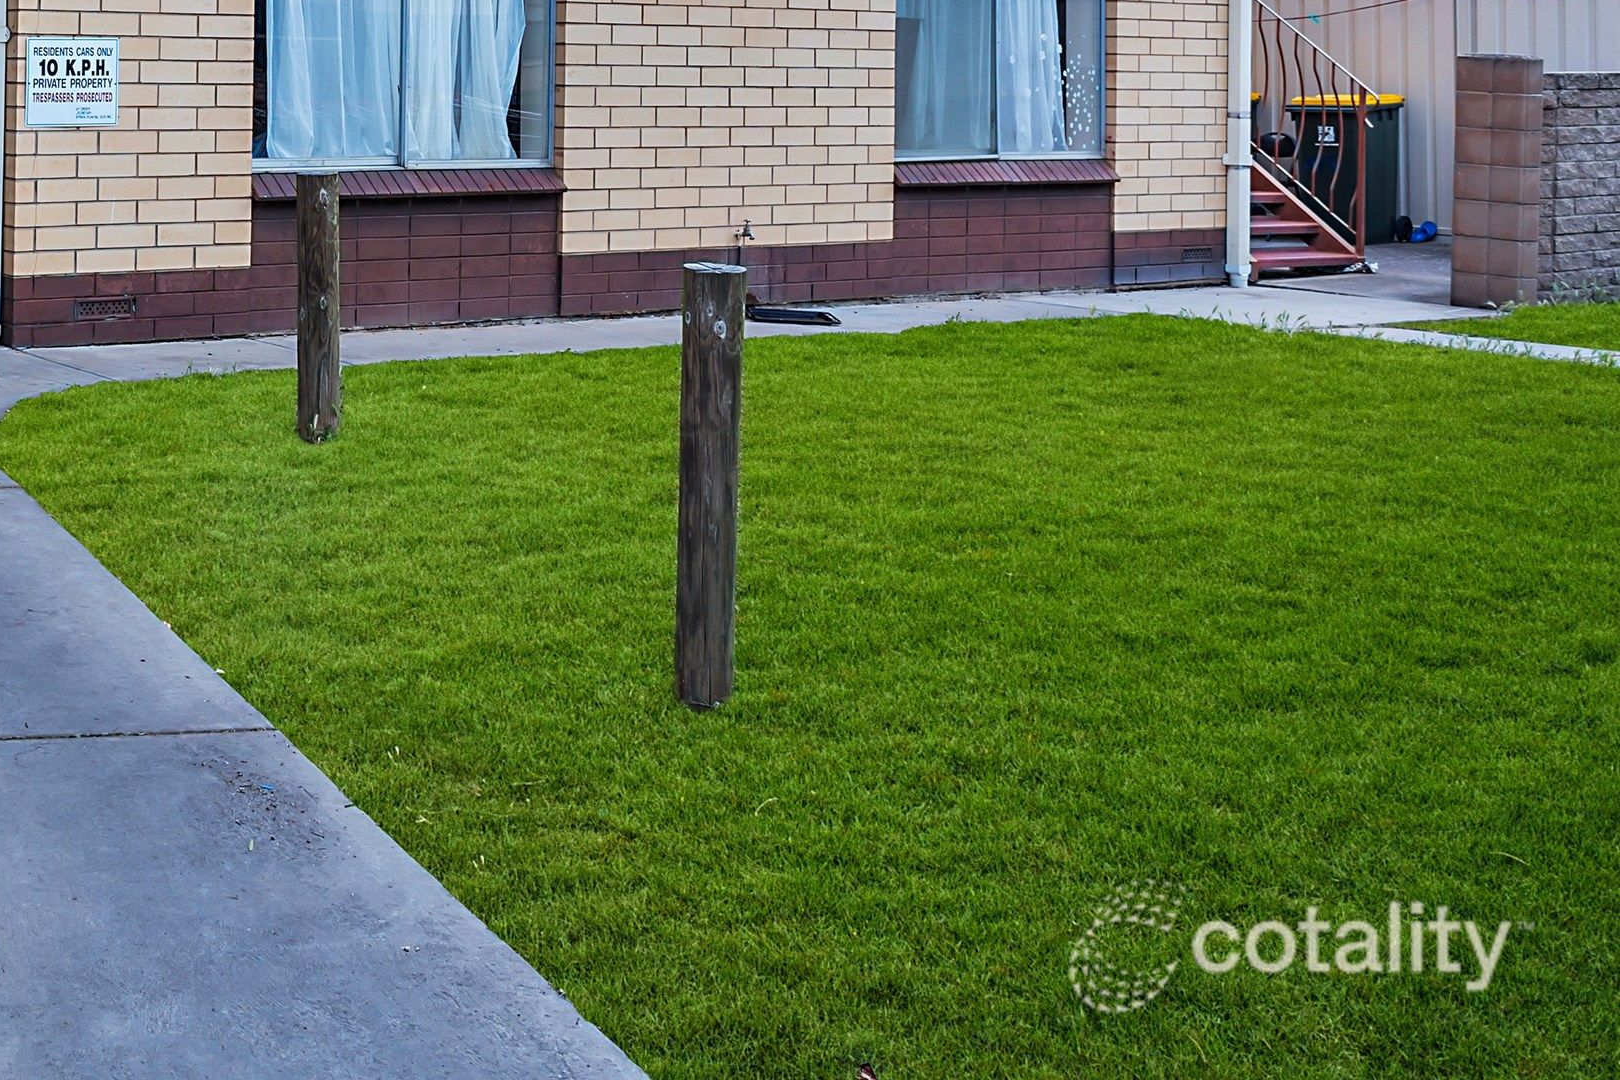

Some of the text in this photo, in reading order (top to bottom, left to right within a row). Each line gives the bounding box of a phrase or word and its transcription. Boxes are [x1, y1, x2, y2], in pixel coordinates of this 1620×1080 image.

[33, 47, 114, 57] RESIDENTS CARS ONLY
[39, 59, 110, 76] 10 K.P.H.
[32, 78, 113, 89] PRIVATE PROPERTY
[32, 92, 113, 103] TRESPASSERS PROSECUTED
